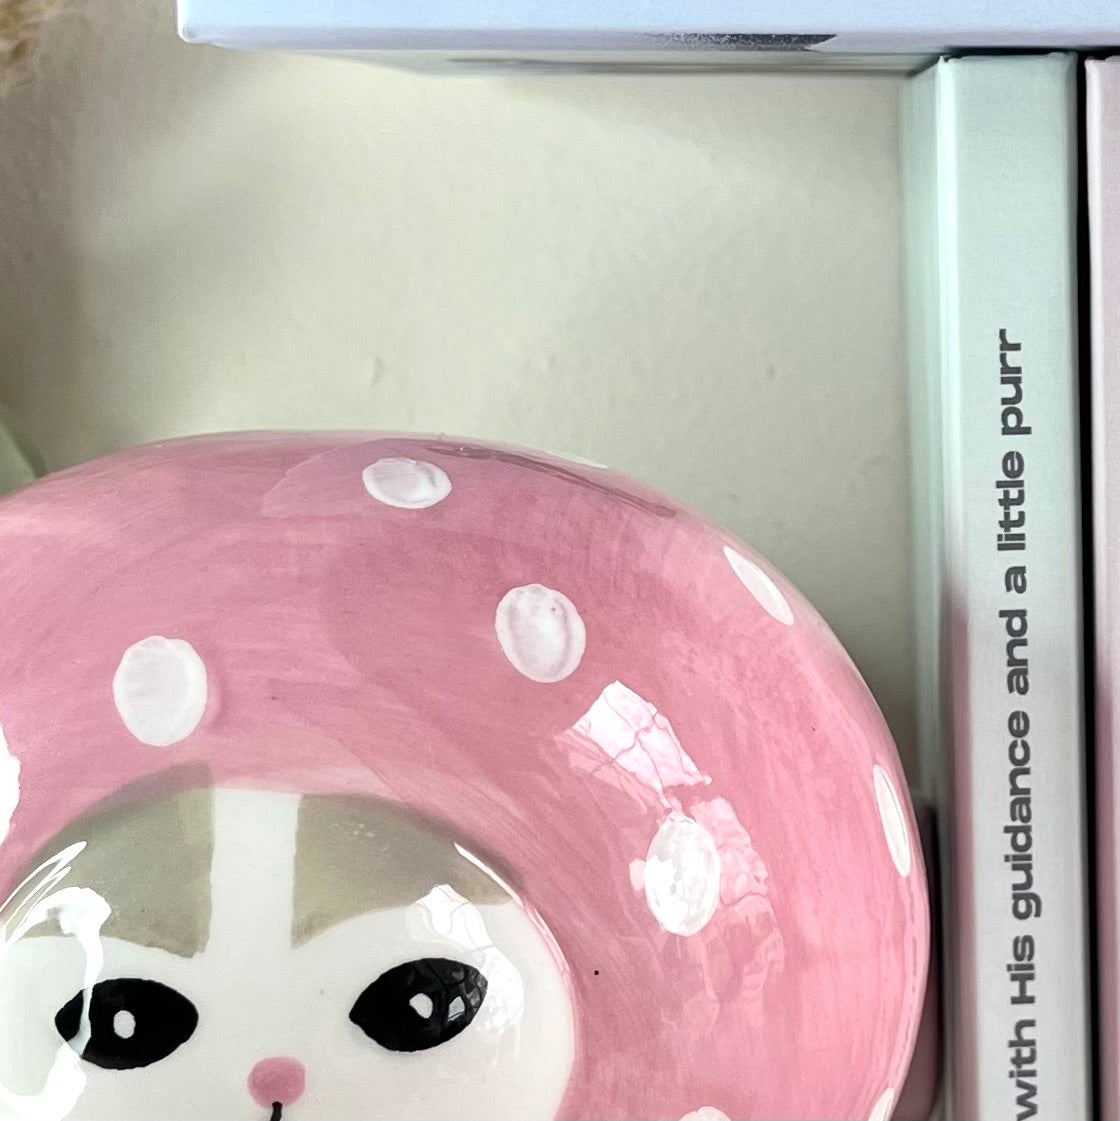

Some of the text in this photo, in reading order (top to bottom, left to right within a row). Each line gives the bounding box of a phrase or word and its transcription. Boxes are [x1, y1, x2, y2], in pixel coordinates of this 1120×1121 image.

[995, 328, 1043, 1121] with His guidance and a little purr
